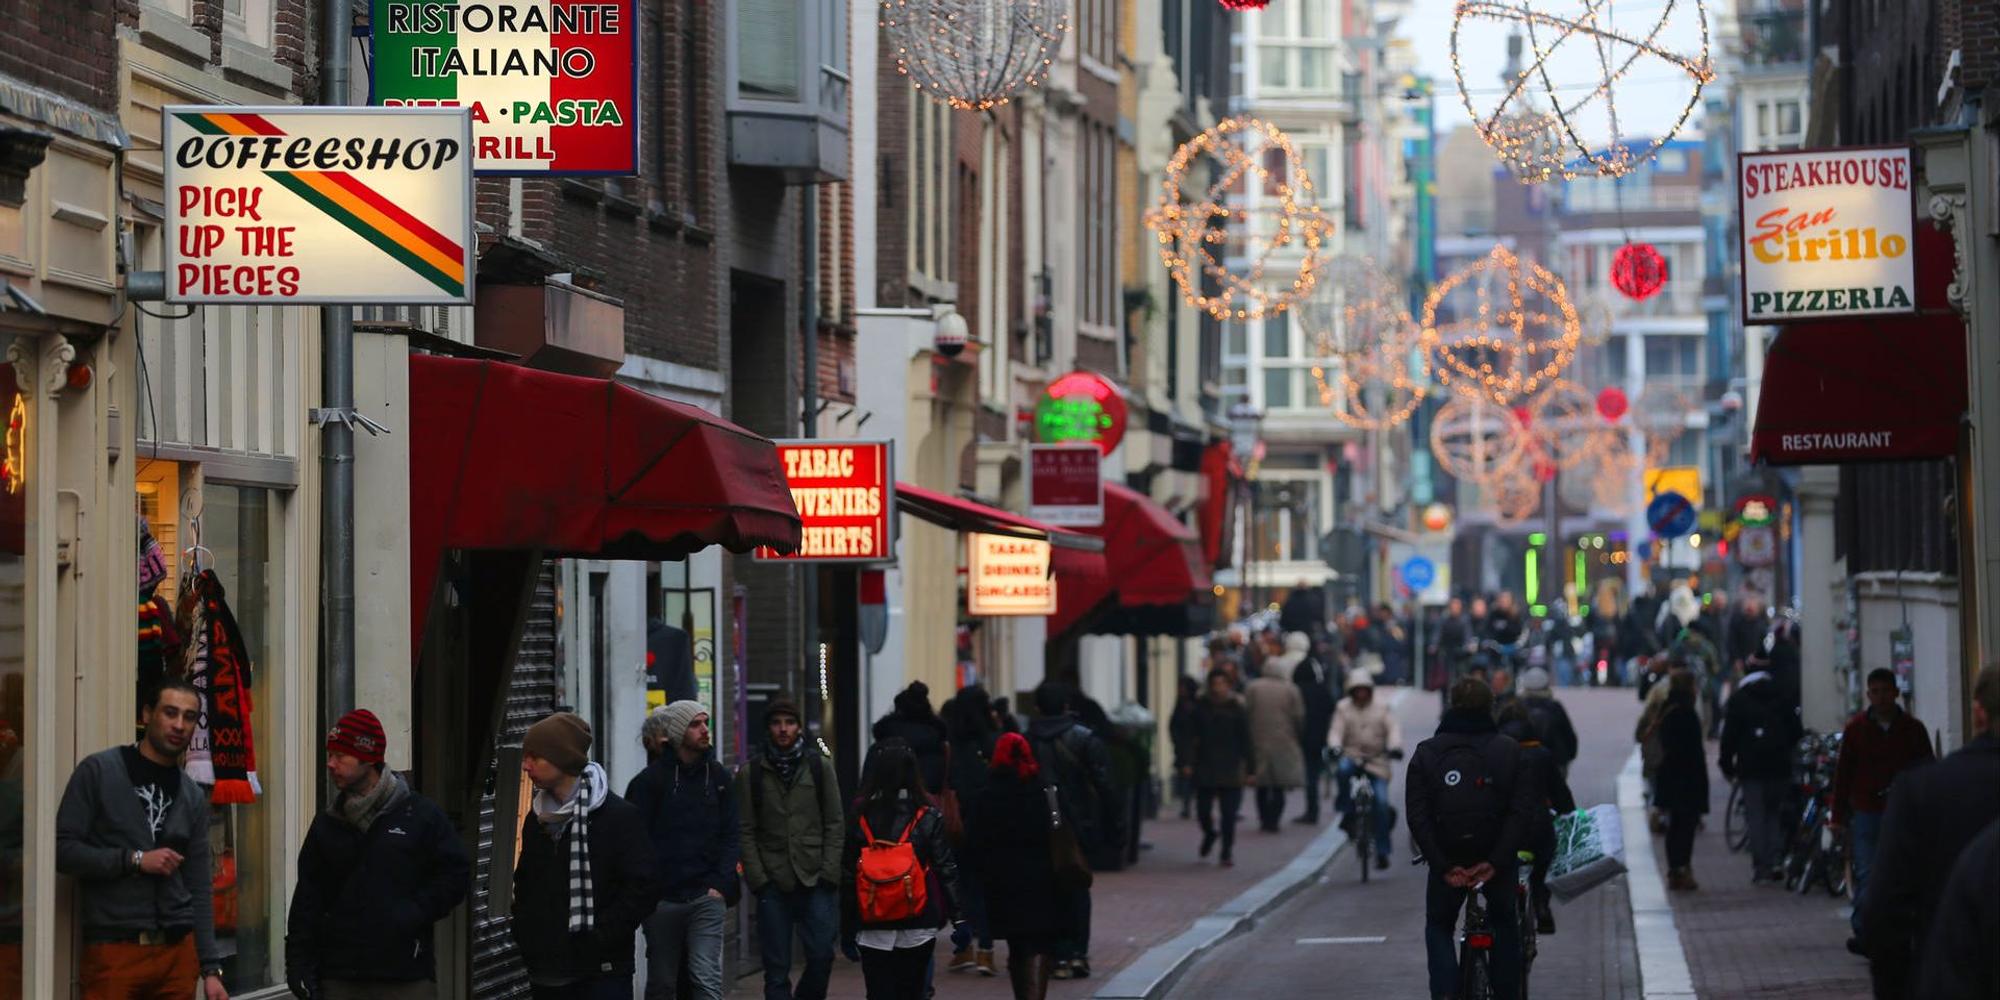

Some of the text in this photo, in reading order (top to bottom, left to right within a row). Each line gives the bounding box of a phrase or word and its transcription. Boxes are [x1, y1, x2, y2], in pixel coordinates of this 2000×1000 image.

[388, 3, 620, 35] RISTORANTE
[411, 46, 596, 79] ITALIANO
[512, 99, 624, 126] PASTA
[175, 136, 460, 171] COFFEESHOP
[473, 135, 556, 162] RILL
[1745, 156, 1909, 199] STEAKHOUSE
[178, 184, 264, 222] PICK
[1749, 206, 1835, 244] San
[179, 224, 297, 259] UP THE
[1752, 227, 1907, 265] Cirillo
[177, 263, 301, 297] PIECES
[1751, 285, 1913, 314] PIZZERIA
[1781, 431, 1893, 451] RESTAURANT
[784, 448, 855, 479] TABAC
[988, 542, 1038, 555] TABAC
[982, 563, 1042, 577] DRINKS
